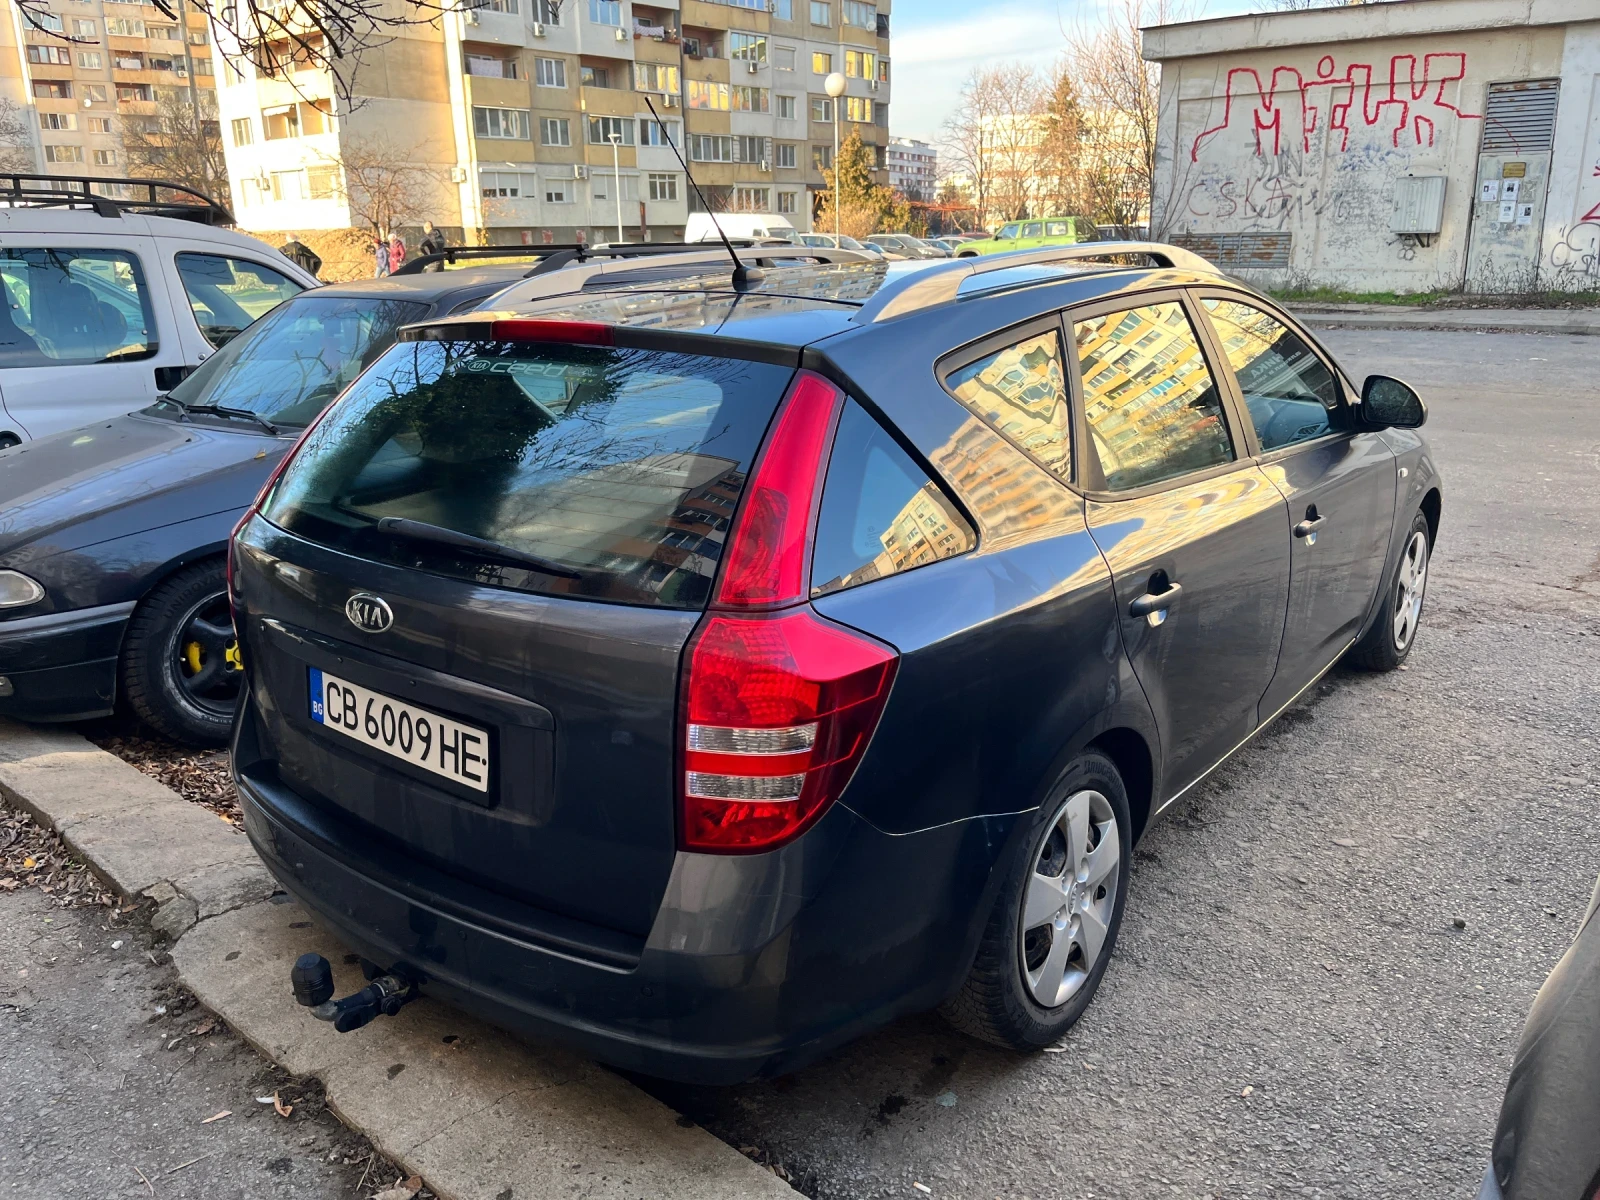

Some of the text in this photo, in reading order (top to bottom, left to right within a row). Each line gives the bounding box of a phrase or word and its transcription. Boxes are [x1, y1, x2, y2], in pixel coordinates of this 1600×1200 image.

[351, 600, 383, 628] KIA
[313, 701, 323, 715] BG
[327, 682, 481, 782] CB 6009 HE
